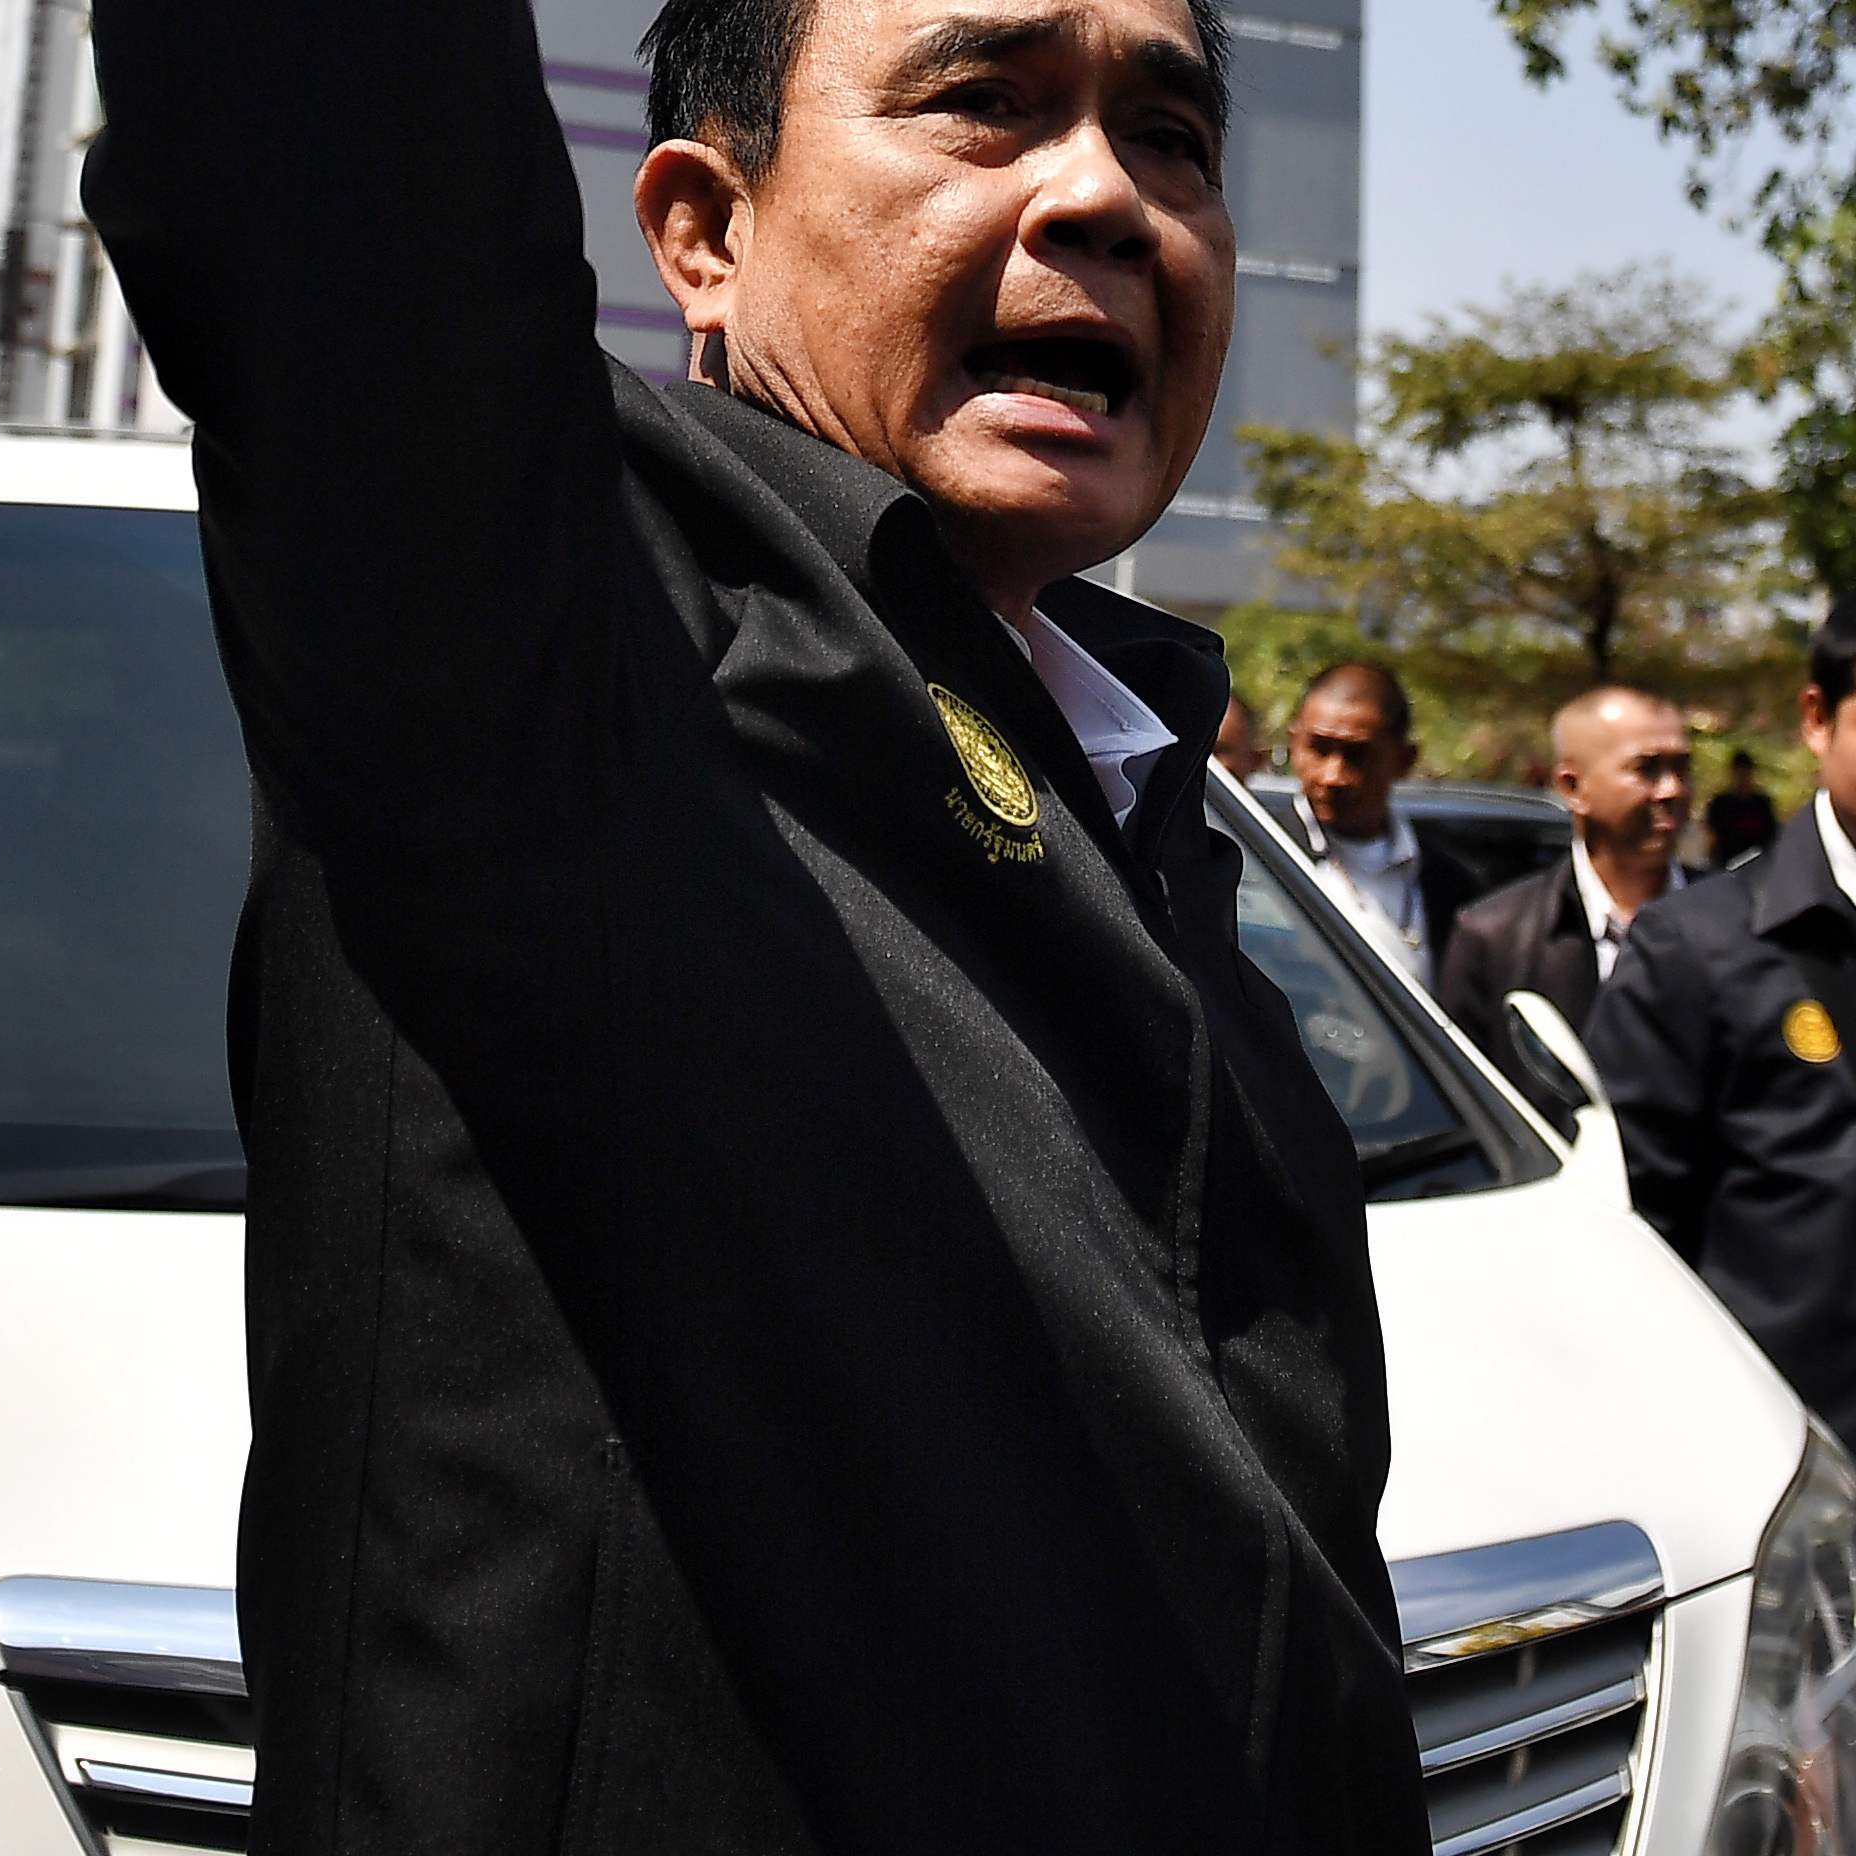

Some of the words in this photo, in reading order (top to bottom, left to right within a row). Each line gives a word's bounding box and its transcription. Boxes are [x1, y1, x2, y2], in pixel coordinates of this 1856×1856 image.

[944, 786, 1045, 865] นายกรัฐมนตรี
